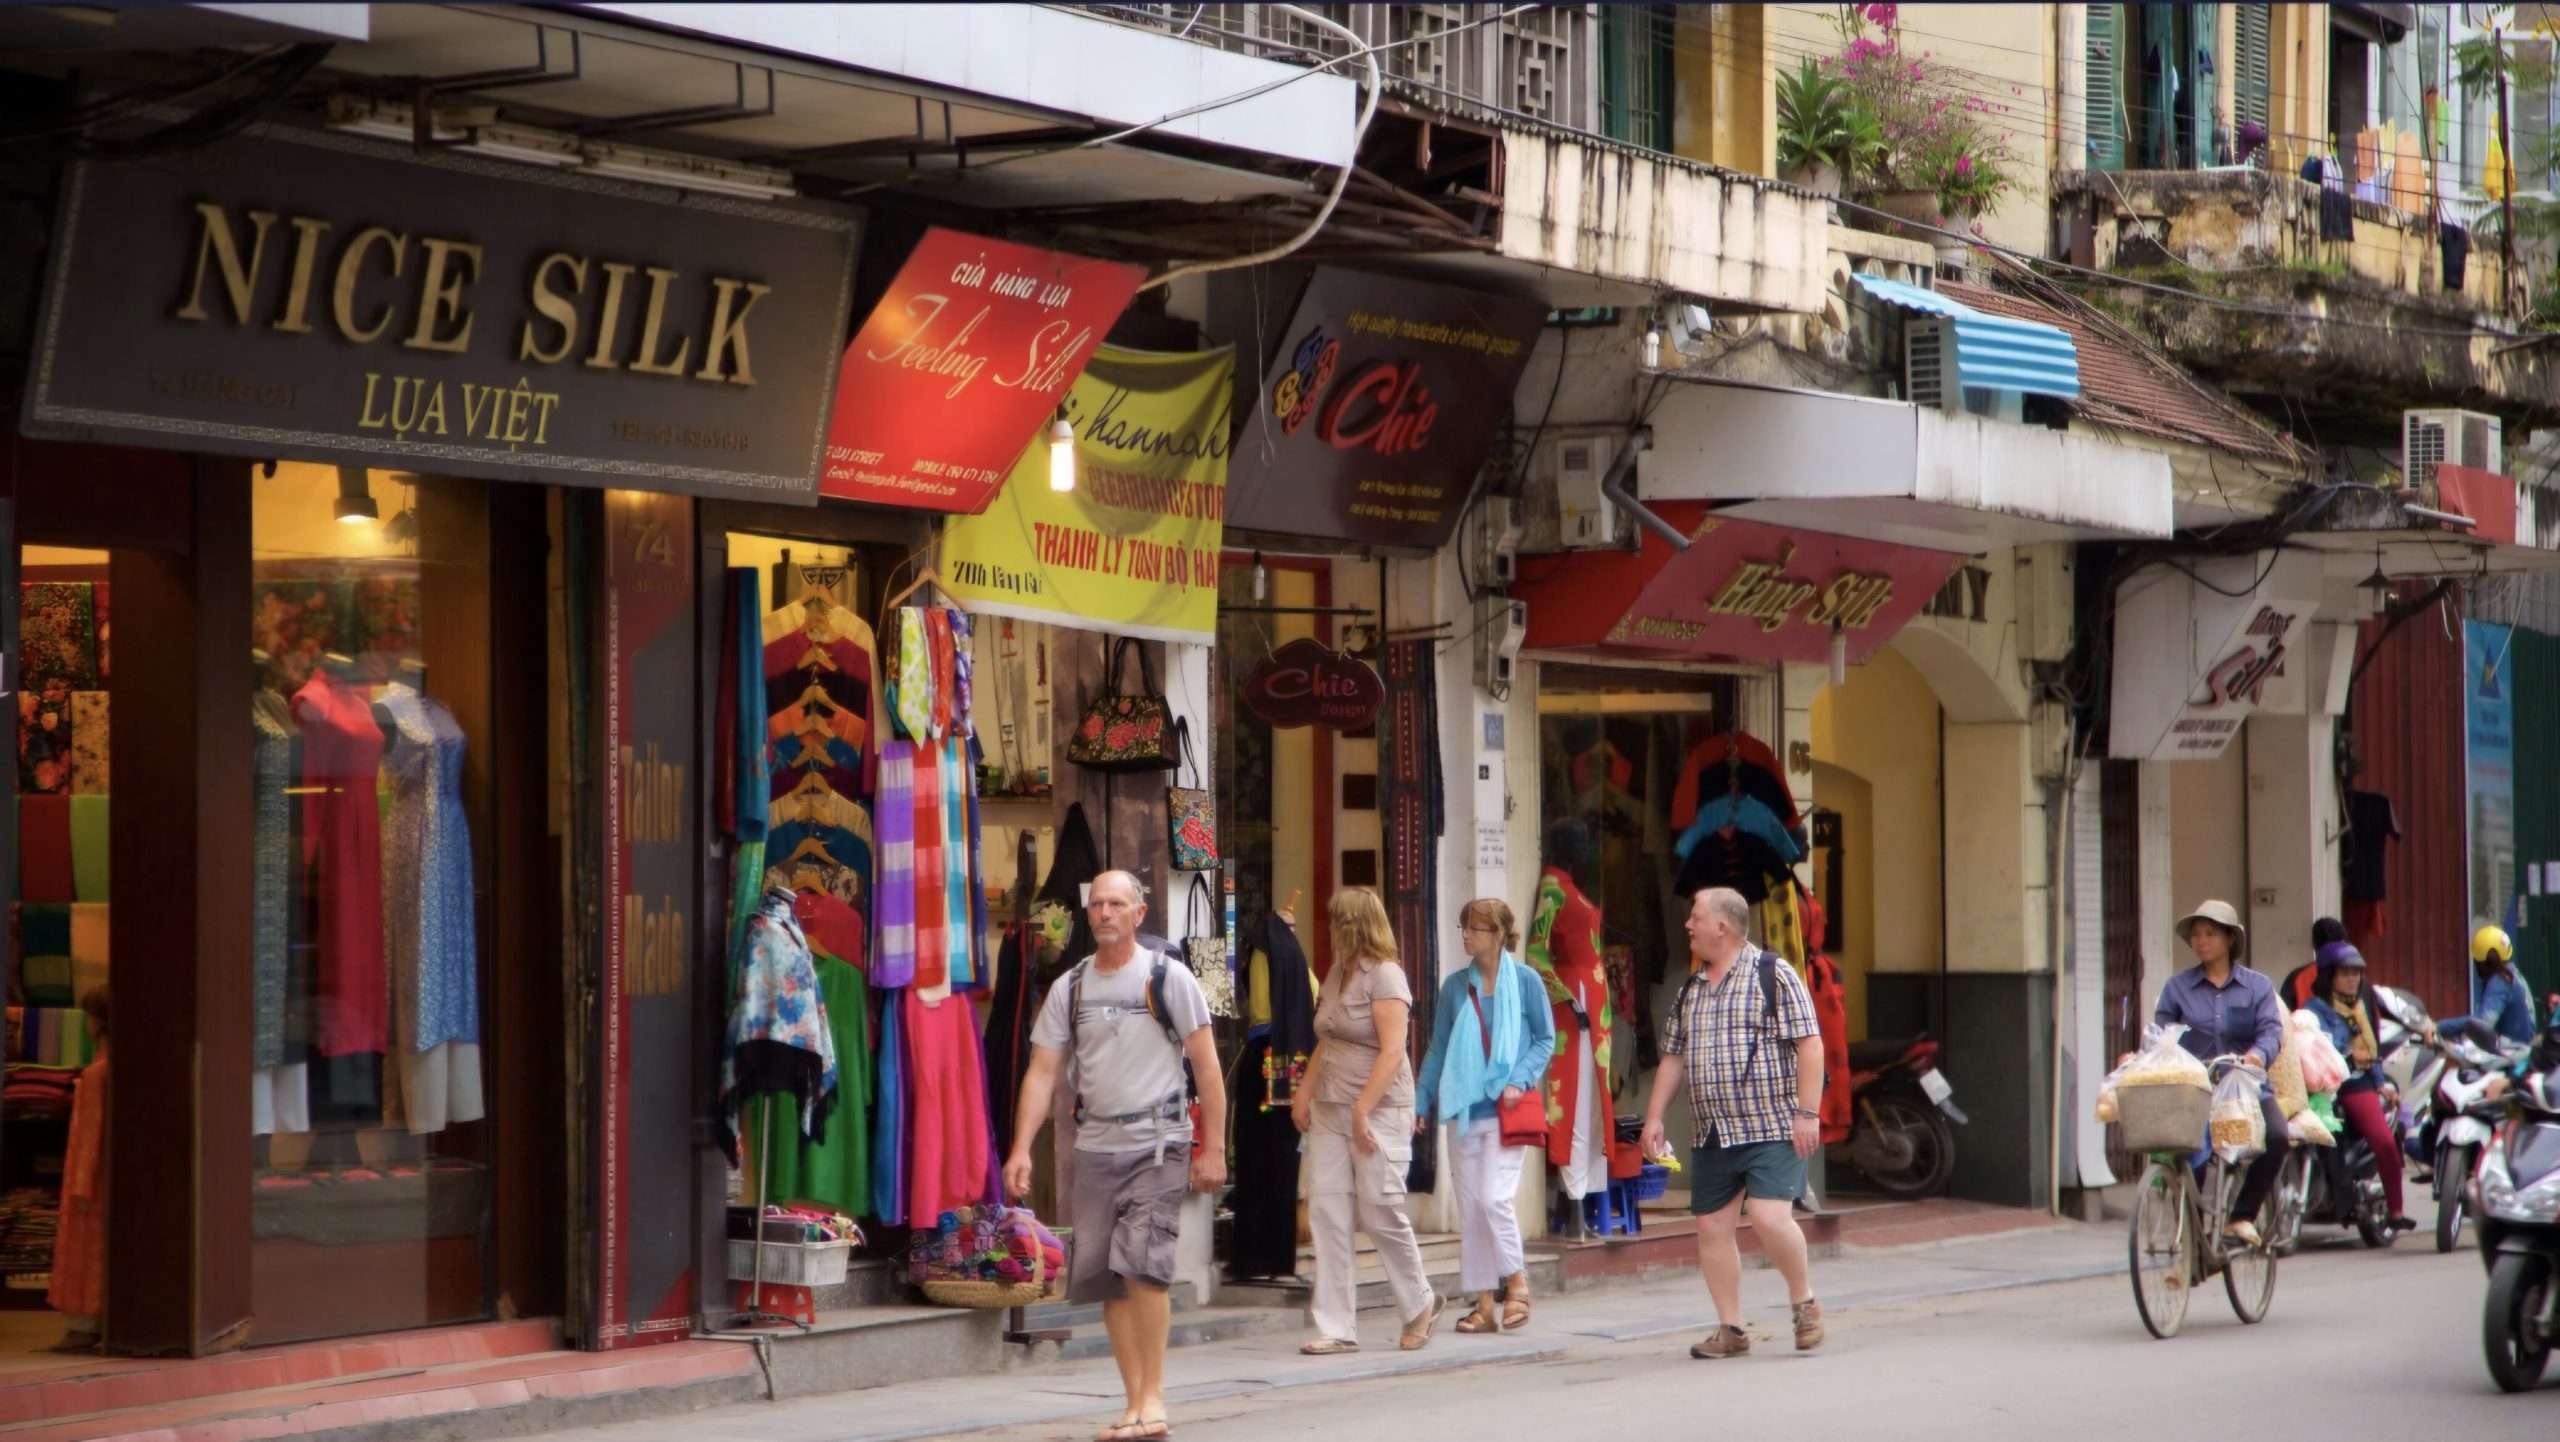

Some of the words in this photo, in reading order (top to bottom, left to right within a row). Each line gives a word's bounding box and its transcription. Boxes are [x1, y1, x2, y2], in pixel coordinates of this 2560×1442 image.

[177, 203, 483, 353] NICE
[519, 252, 771, 387] SILK
[867, 293, 991, 400] Feeling
[992, 319, 1091, 392] Silk
[1319, 361, 1438, 457] Chie
[629, 522, 676, 567] 74
[1034, 521, 1098, 571] THANH
[1803, 572, 1894, 629] Silk
[1264, 663, 1359, 699] Chie
[619, 740, 685, 842] Tailor
[622, 892, 684, 996] Made
